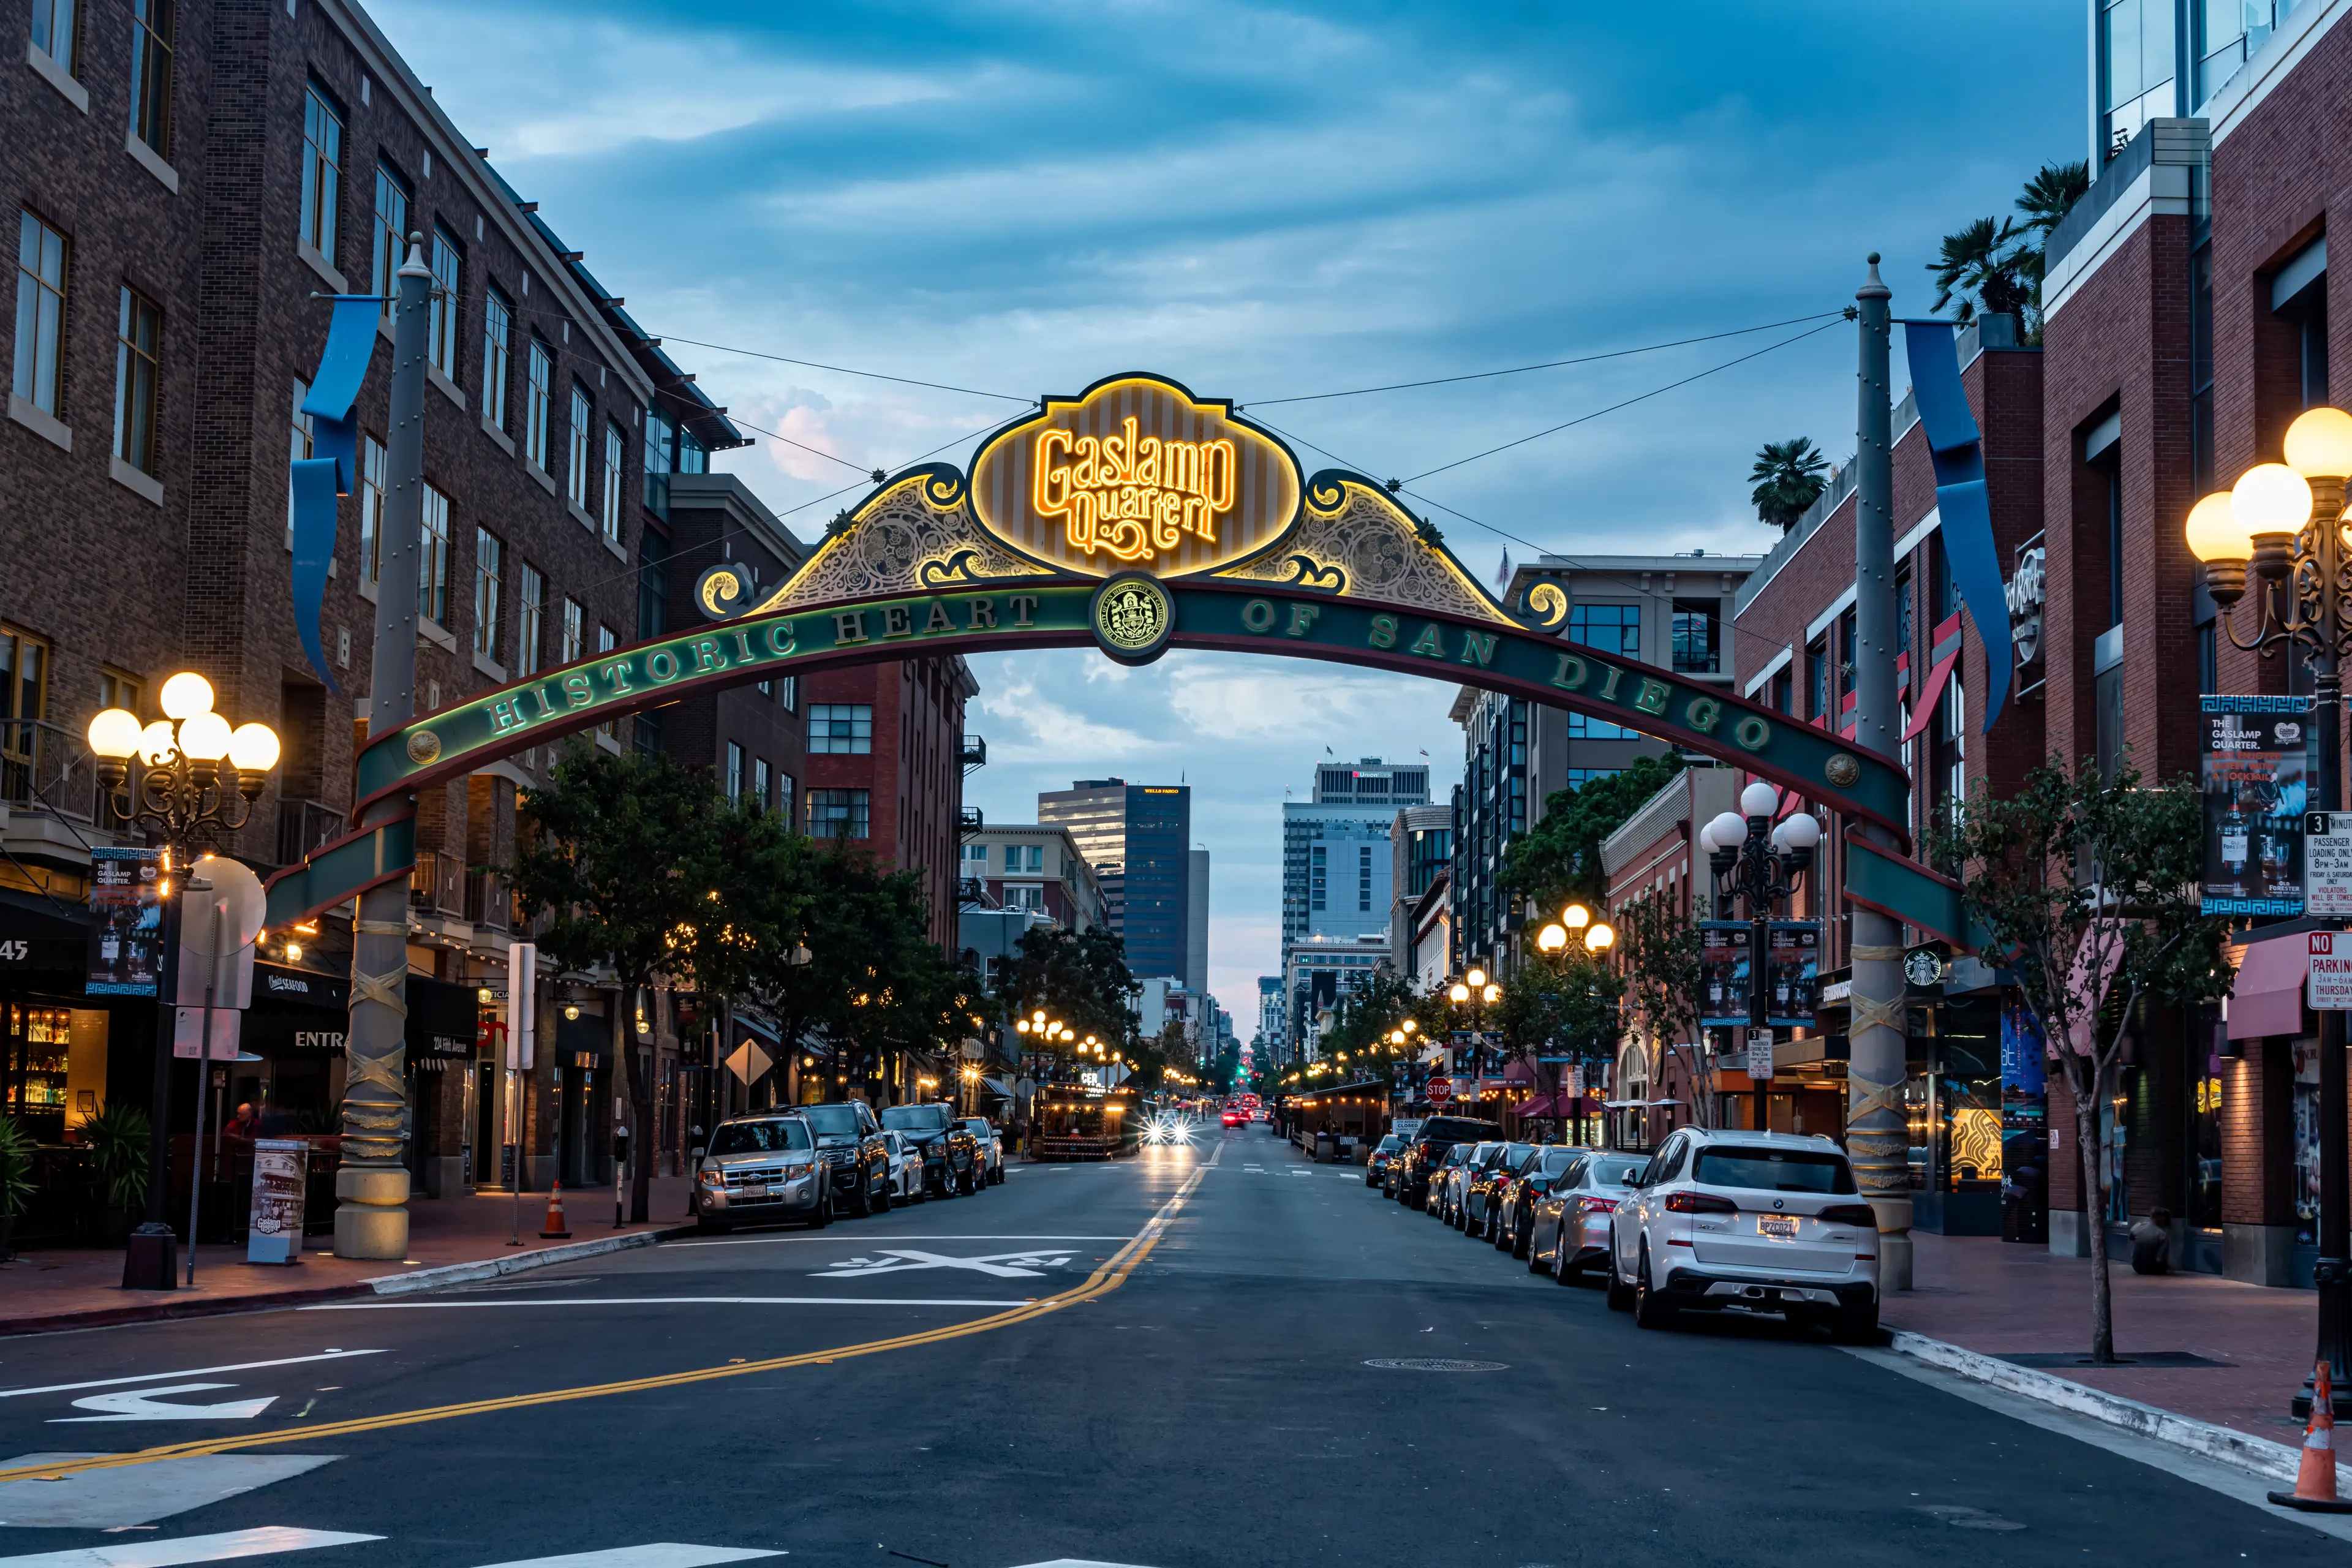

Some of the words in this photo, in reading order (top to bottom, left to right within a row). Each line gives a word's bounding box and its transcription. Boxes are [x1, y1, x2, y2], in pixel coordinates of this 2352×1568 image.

[1033, 415, 1236, 540] Gaslamp
[1067, 486, 1204, 560] Quarter
[1113, 586, 1129, 595] DIEGO
[1132, 584, 1148, 594] STATE
[1104, 595, 1114, 605] SAN
[1155, 599, 1164, 631] CALIFORNIA
[1105, 627, 1114, 638] THE
[2011, 625, 2026, 643] HOTEL
[1135, 635, 1154, 646] VIGILANS
[485, 621, 796, 734] HISTORIC
[831, 594, 1039, 645] HEART
[1242, 598, 1319, 635] OF
[1368, 614, 1499, 665] SAN
[1550, 652, 1771, 750] DIEGO
[2212, 719, 2230, 728] THE
[2212, 730, 2261, 739] GASLAMP
[2212, 741, 2261, 750] QUARTER.
[2212, 751, 2234, 760] BEST
[2237, 752, 2283, 760] ENJOYED
[2212, 761, 2247, 770] SAFELY
[2314, 815, 2323, 832] 3
[2314, 837, 2350, 846] PASSENGER
[2309, 848, 2335, 858] LOADING
[2312, 935, 2329, 952] NO
[0, 940, 28, 960] 45
[2313, 959, 2352, 973] PARKIN
[282, 978, 308, 993] SEAFOOD
[442, 1037, 451, 1052] Fifth
[452, 1039, 466, 1053] Avenue
[1428, 1085, 1450, 1095] STOP
[1340, 1136, 1359, 1145] UNION
[1760, 1221, 1792, 1232] 8PZC021
